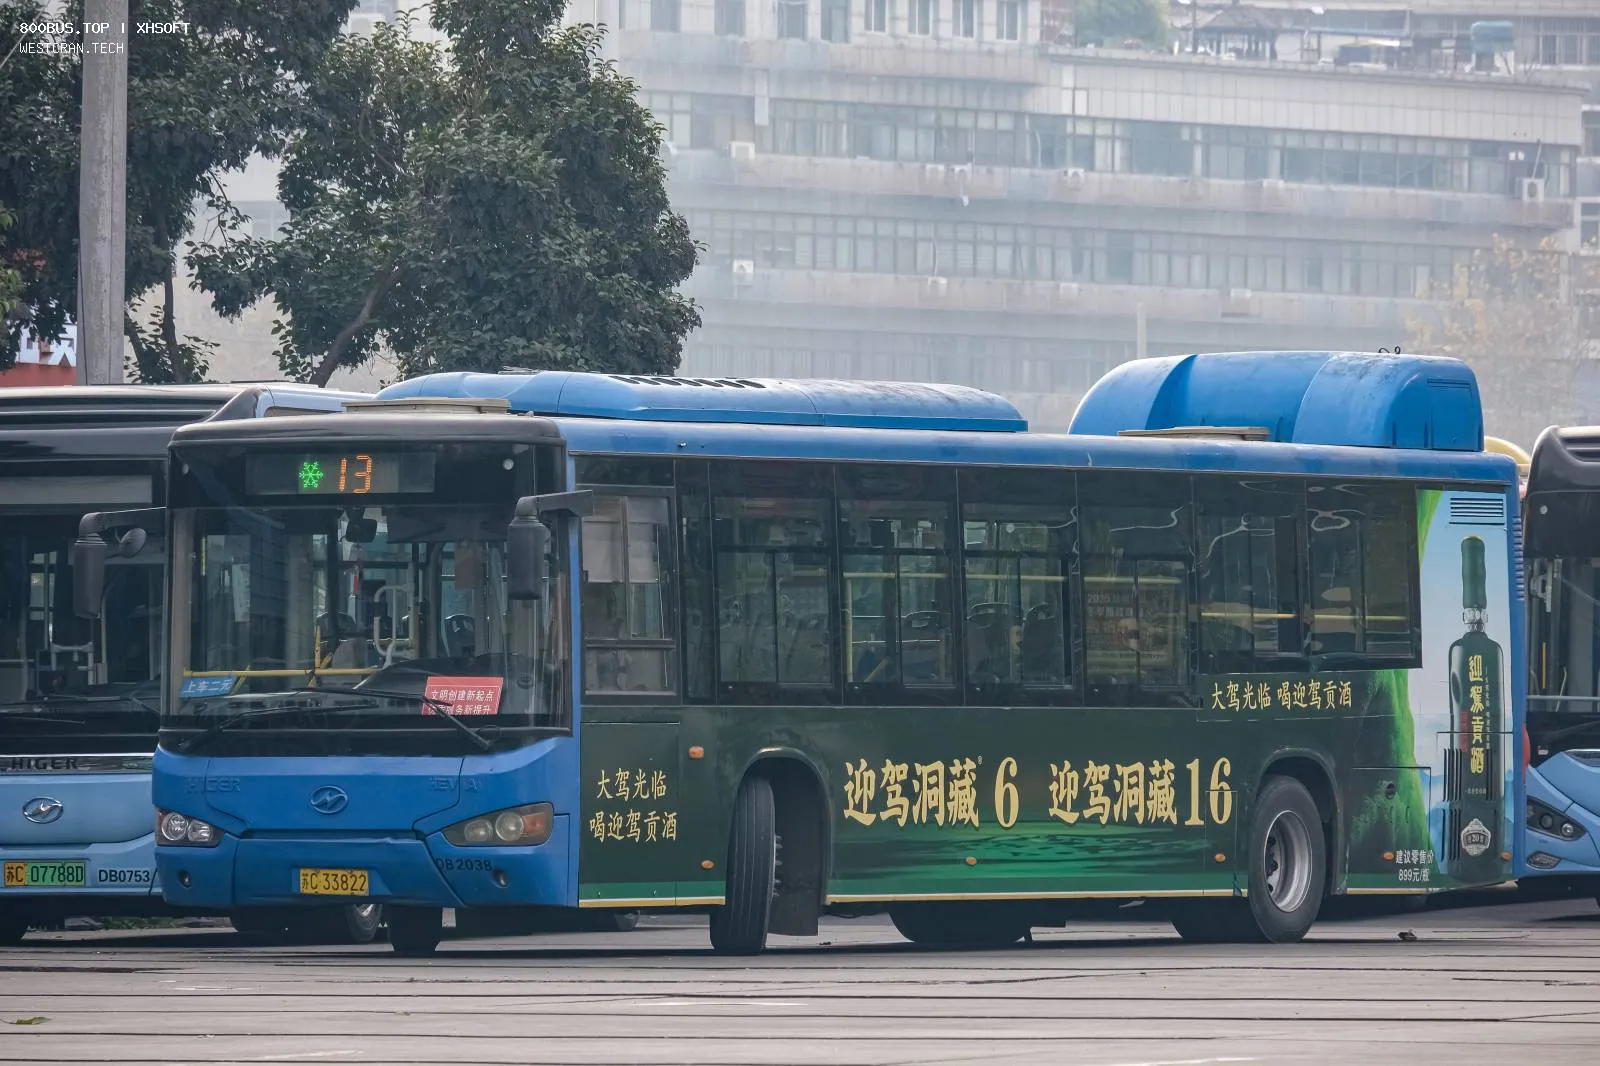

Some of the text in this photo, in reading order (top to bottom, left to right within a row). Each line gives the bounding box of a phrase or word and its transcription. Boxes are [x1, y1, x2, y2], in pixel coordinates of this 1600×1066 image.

[338, 455, 374, 494] 13
[183, 679, 233, 693] 上车二元
[431, 689, 494, 702] 文明创建新起点
[1211, 680, 1351, 711] 大驾光临 喝迎驾贡酒
[11, 758, 78, 770] HIGER
[596, 767, 667, 800] 大驾光临
[843, 756, 1019, 828] 迎驾洞藏 6
[589, 810, 677, 843] 喝迎驾贡酒
[1396, 850, 1434, 864] 建议零售价
[435, 858, 493, 871] DB2038
[98, 870, 150, 883] DB0753
